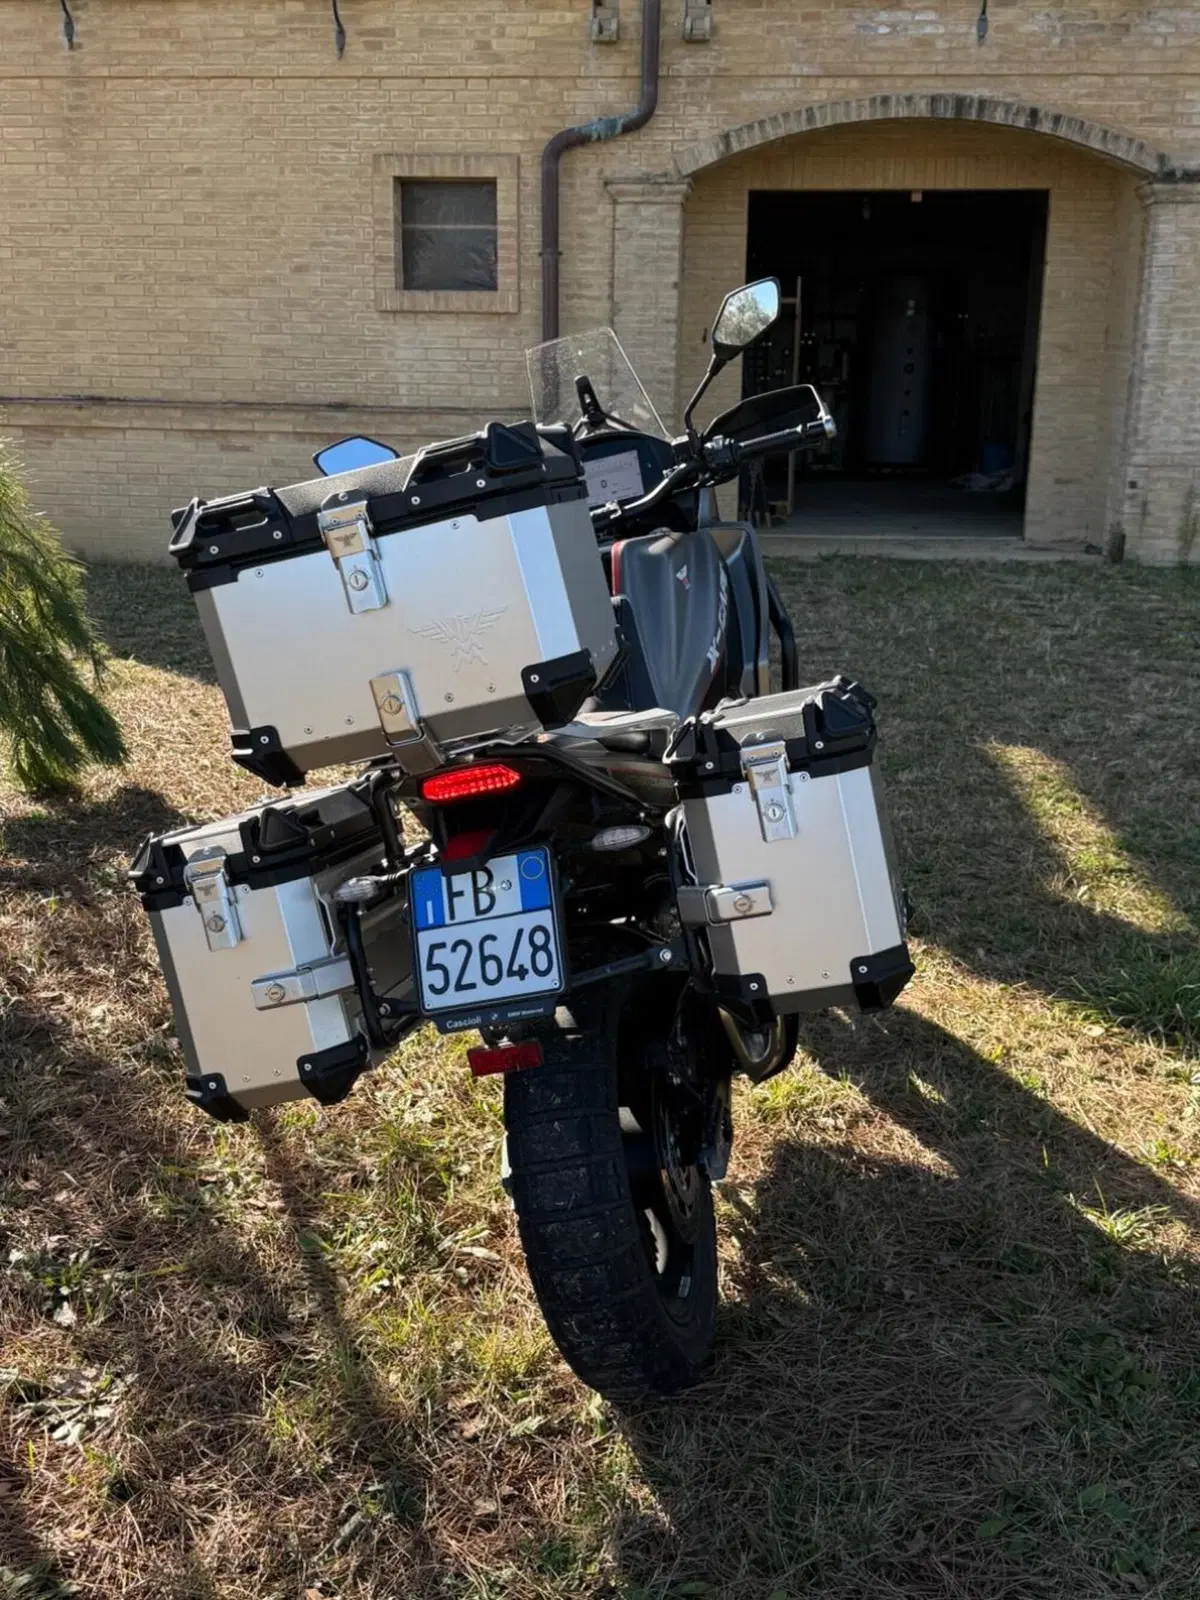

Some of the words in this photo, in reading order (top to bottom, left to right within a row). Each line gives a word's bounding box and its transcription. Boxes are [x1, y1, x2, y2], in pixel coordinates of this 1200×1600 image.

[448, 866, 497, 921] FB
[426, 925, 554, 995] 52648
[446, 1016, 482, 1029] Cascioli
